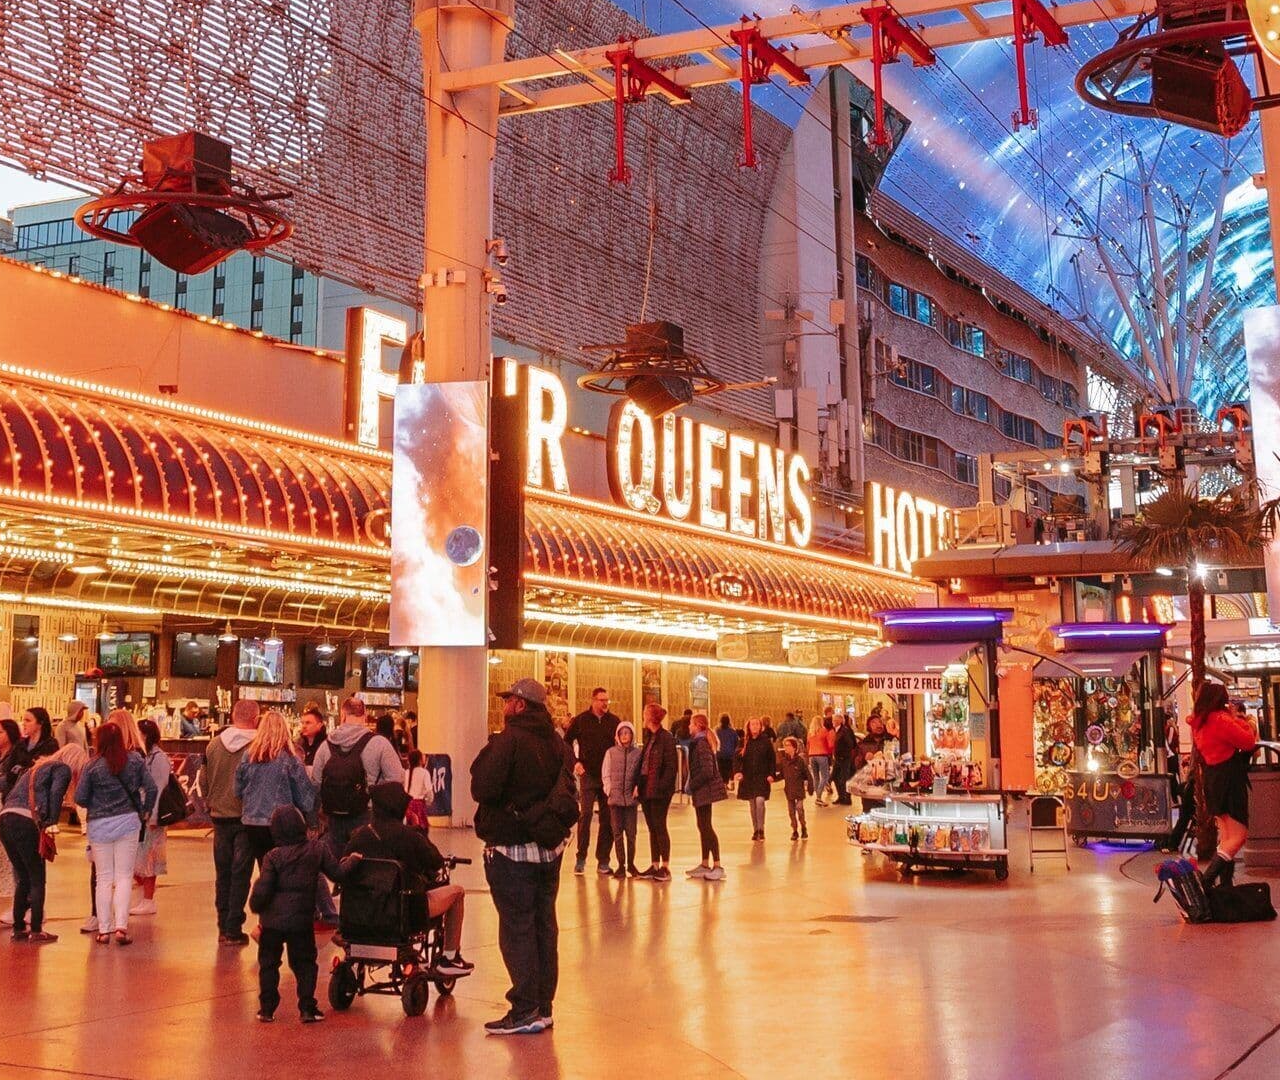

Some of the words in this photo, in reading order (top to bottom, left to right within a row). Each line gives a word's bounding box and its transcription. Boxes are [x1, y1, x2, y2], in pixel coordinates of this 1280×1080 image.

[358, 307, 570, 494] FR
[617, 399, 811, 548] QUEENS
[868, 677, 886, 689] BUY
[887, 677, 894, 689] 3
[895, 677, 912, 690] GET
[913, 677, 920, 690] 2
[921, 677, 942, 690] FREE
